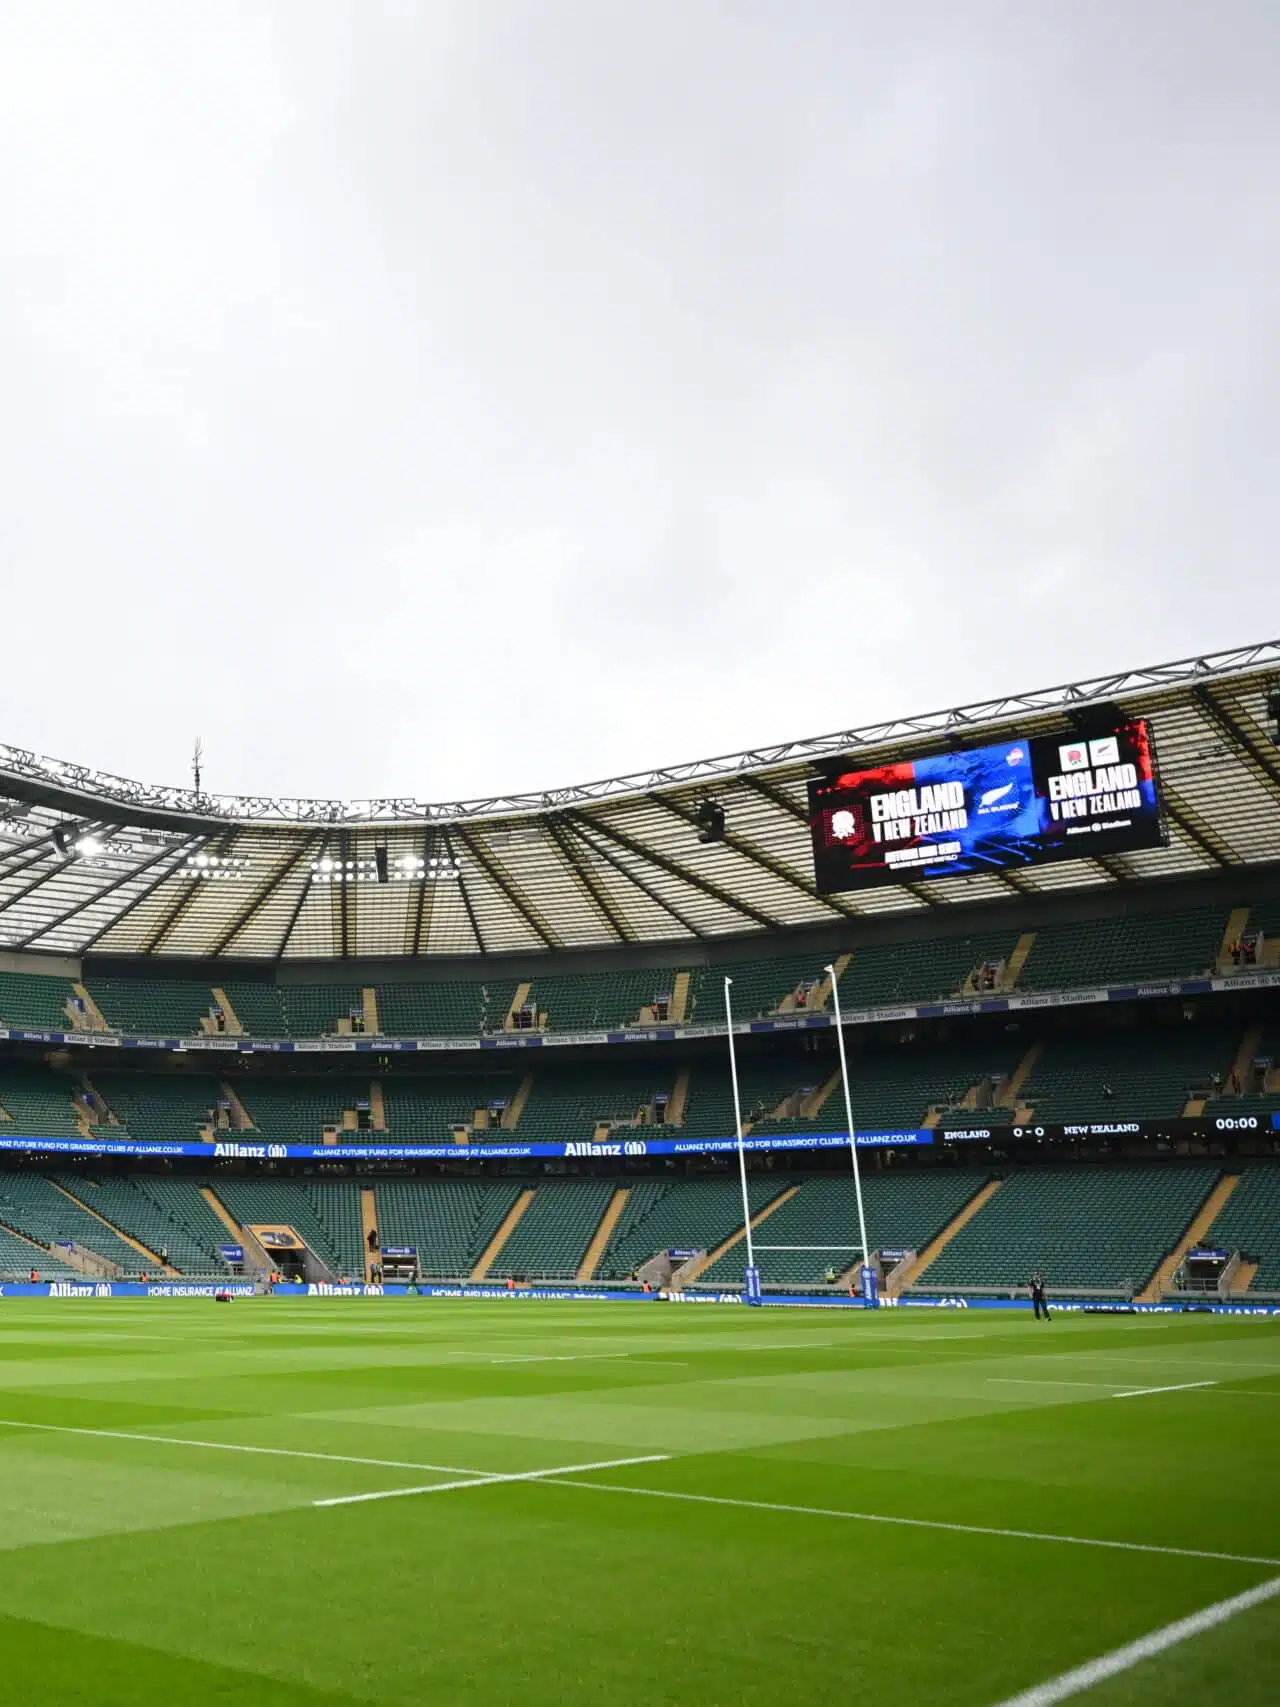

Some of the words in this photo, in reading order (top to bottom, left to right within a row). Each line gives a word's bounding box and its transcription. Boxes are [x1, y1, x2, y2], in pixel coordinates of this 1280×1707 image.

[1047, 763, 1137, 801] ENGLAND
[870, 781, 964, 822] ENGLAND
[1050, 802, 1060, 821] V
[1061, 797, 1087, 819] NEW
[1090, 789, 1141, 814] ZEALAND
[872, 823, 881, 843] V
[883, 817, 911, 841] NEW
[913, 808, 967, 836] ZEALAND
[1216, 1117, 1258, 1129] 00:00
[944, 1129, 990, 1140] ENGLAND
[1013, 1128, 1022, 1137] 0
[1035, 1127, 1044, 1137] 0
[1064, 1125, 1088, 1135] NEW
[1090, 1123, 1139, 1134] ZEALAND
[13, 1140, 37, 1149] FUTURE
[38, 1141, 56, 1149] FUND
[56, 1142, 69, 1150] FOR
[70, 1142, 106, 1152] GRASSROOT
[126, 1145, 134, 1153] AT
[135, 1145, 184, 1154] ALLIANZ.CO.UK
[564, 1142, 622, 1157] Allianz
[675, 1143, 704, 1151] ALLIANZ
[705, 1142, 732, 1150] FUTURE
[734, 1141, 755, 1149] FND
[755, 1140, 771, 1148] FOR
[772, 1138, 818, 1148] GRASSROOT
[819, 1137, 843, 1146] CLUBS
[857, 1134, 917, 1144] ALLIANZ.CO.UK
[214, 1143, 265, 1158] Allianz
[312, 1148, 342, 1156] ALLIANZ
[342, 1148, 369, 1156] FUTURE
[369, 1148, 388, 1156] FUND
[389, 1148, 403, 1156] FOR
[470, 1148, 479, 1156] AT
[480, 1147, 531, 1156] ALLIANZ.CO.UK
[49, 1283, 93, 1297] Allianz
[147, 1286, 171, 1296] HOME
[173, 1286, 214, 1296] INSURANCE
[215, 1286, 224, 1296] AT
[308, 1284, 361, 1296] Allianz
[432, 1289, 462, 1297] HOME
